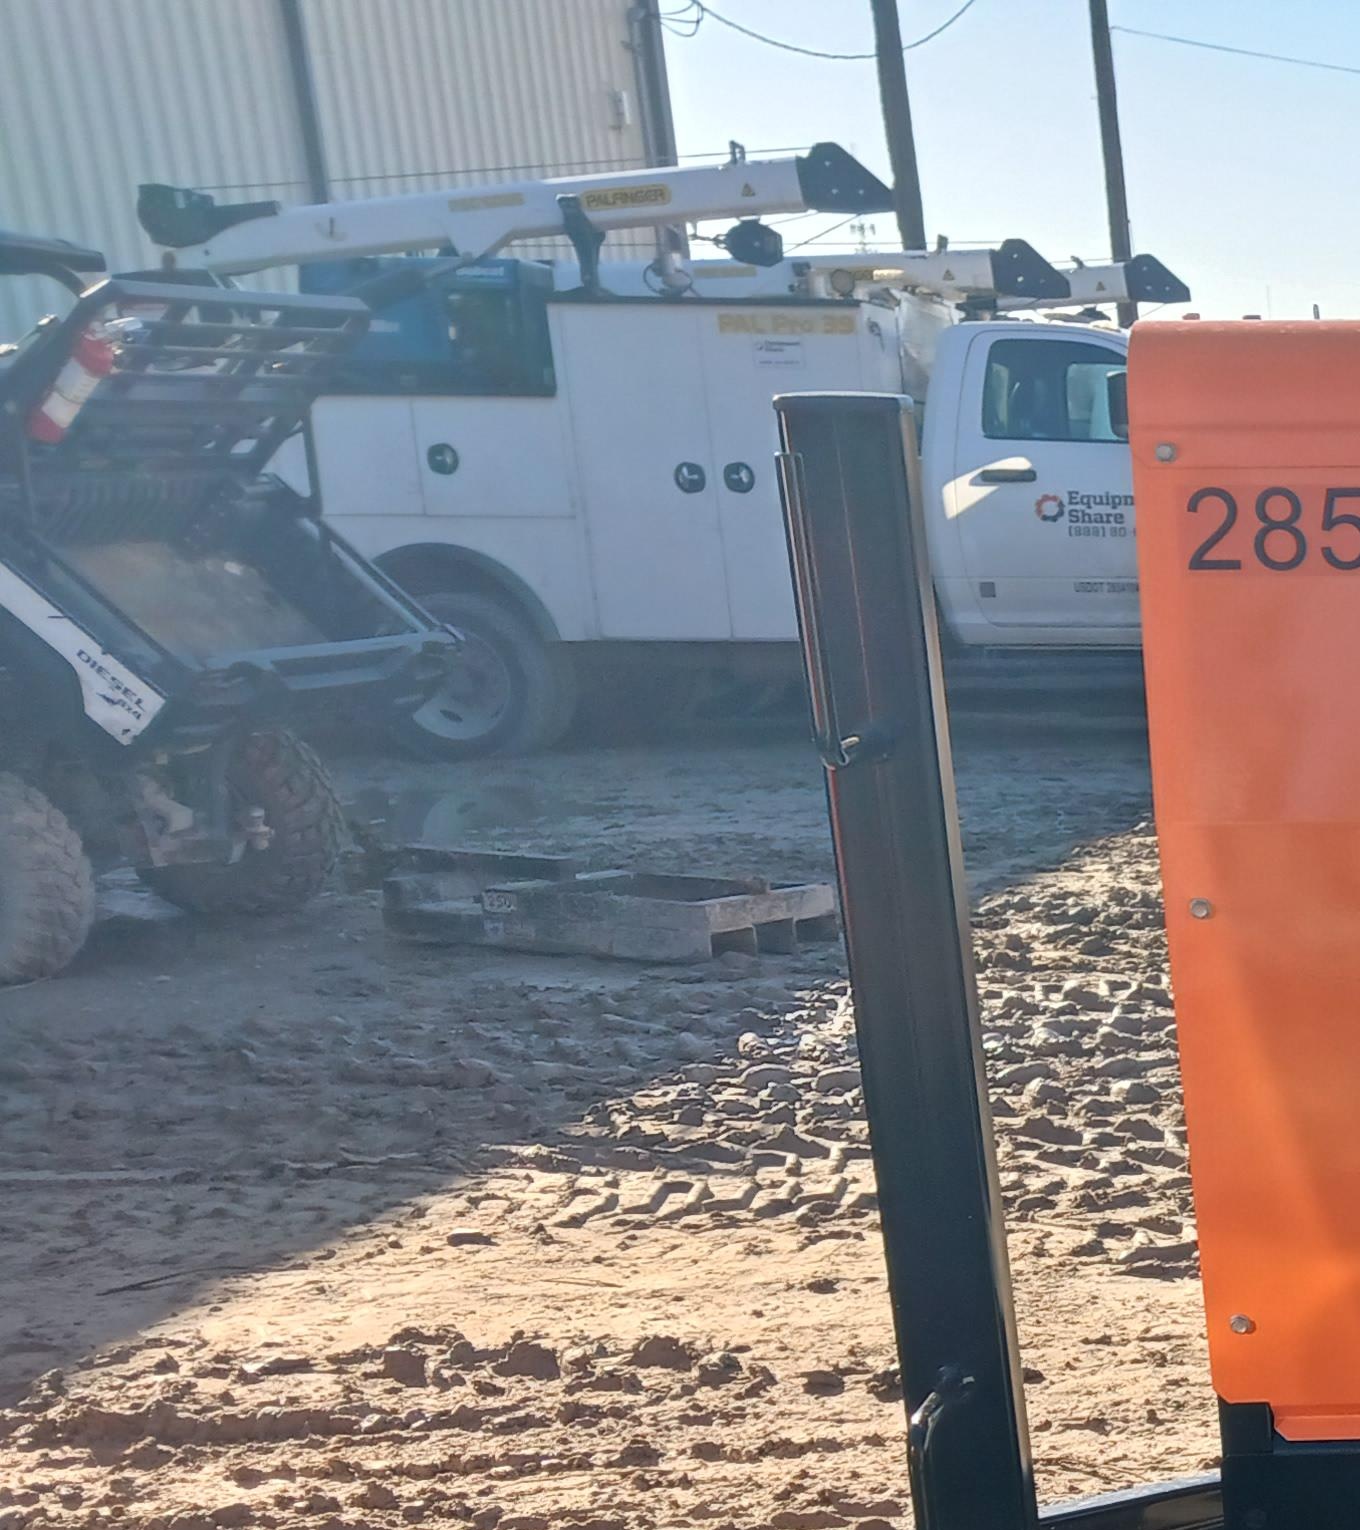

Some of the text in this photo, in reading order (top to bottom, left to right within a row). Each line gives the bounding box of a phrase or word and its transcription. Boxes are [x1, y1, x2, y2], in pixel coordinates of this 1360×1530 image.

[584, 187, 665, 208] PALFINGER
[1067, 508, 1125, 525] Share
[77, 648, 147, 713] DIESEL
